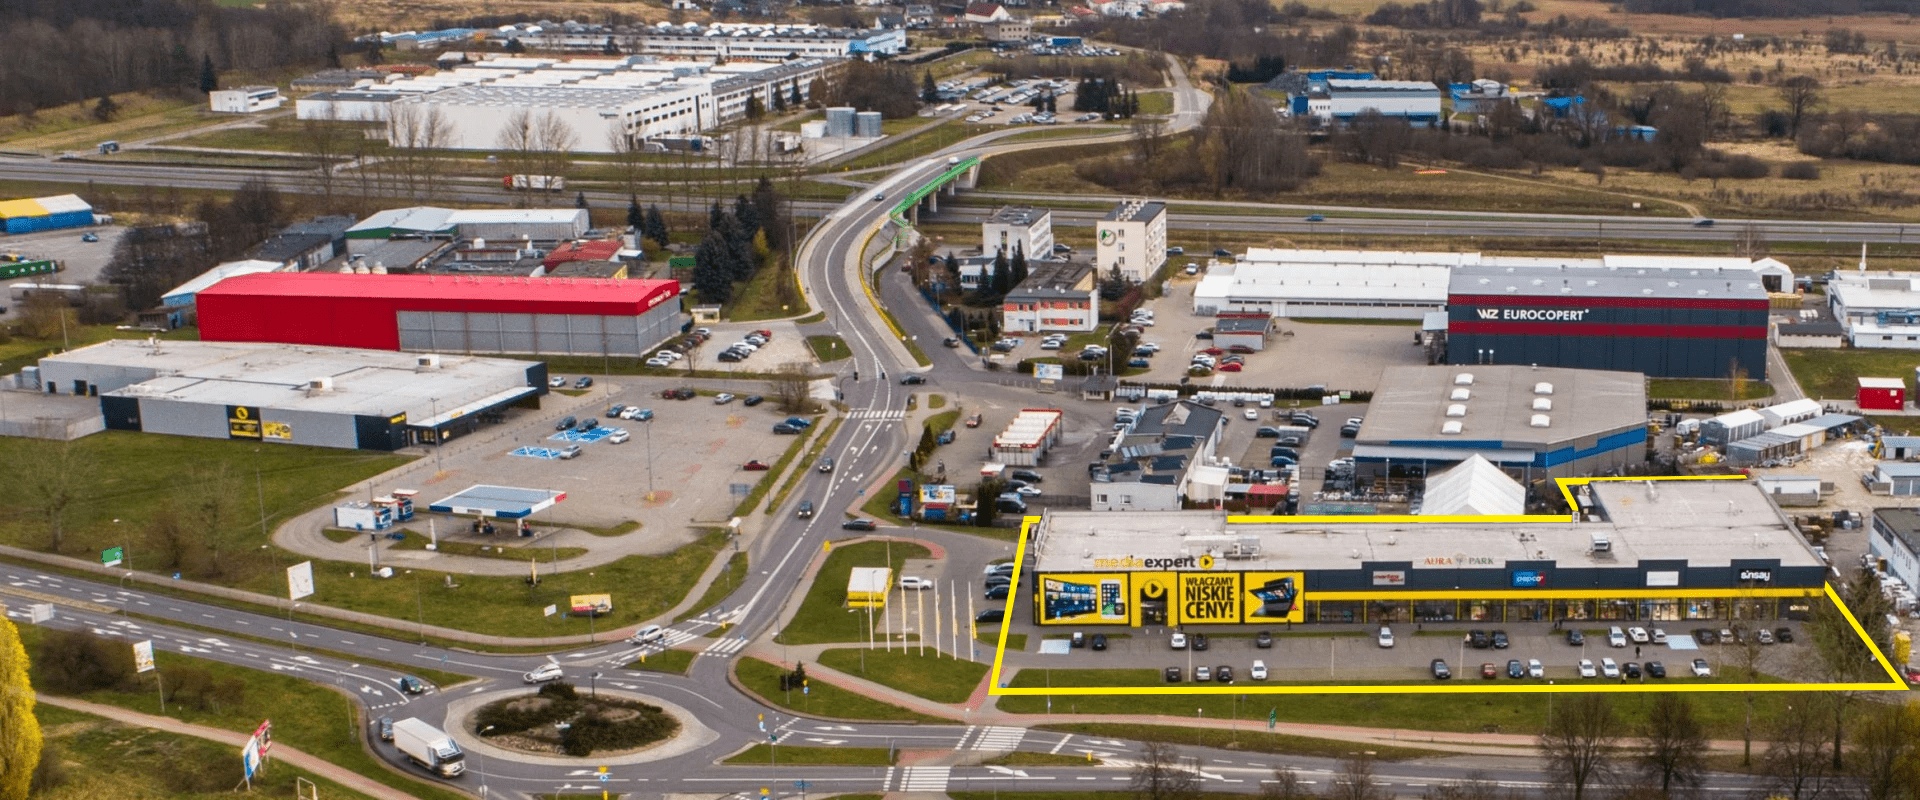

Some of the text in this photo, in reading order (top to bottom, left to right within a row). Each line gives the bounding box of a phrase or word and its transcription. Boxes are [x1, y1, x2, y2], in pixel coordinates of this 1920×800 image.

[1503, 308, 1584, 321] EUROCOPERT
[1423, 557, 1495, 566] AURA PARK
[1740, 569, 1771, 582] sinsay
[1185, 586, 1234, 601] NISKIE
[1185, 601, 1234, 619] CENY!
